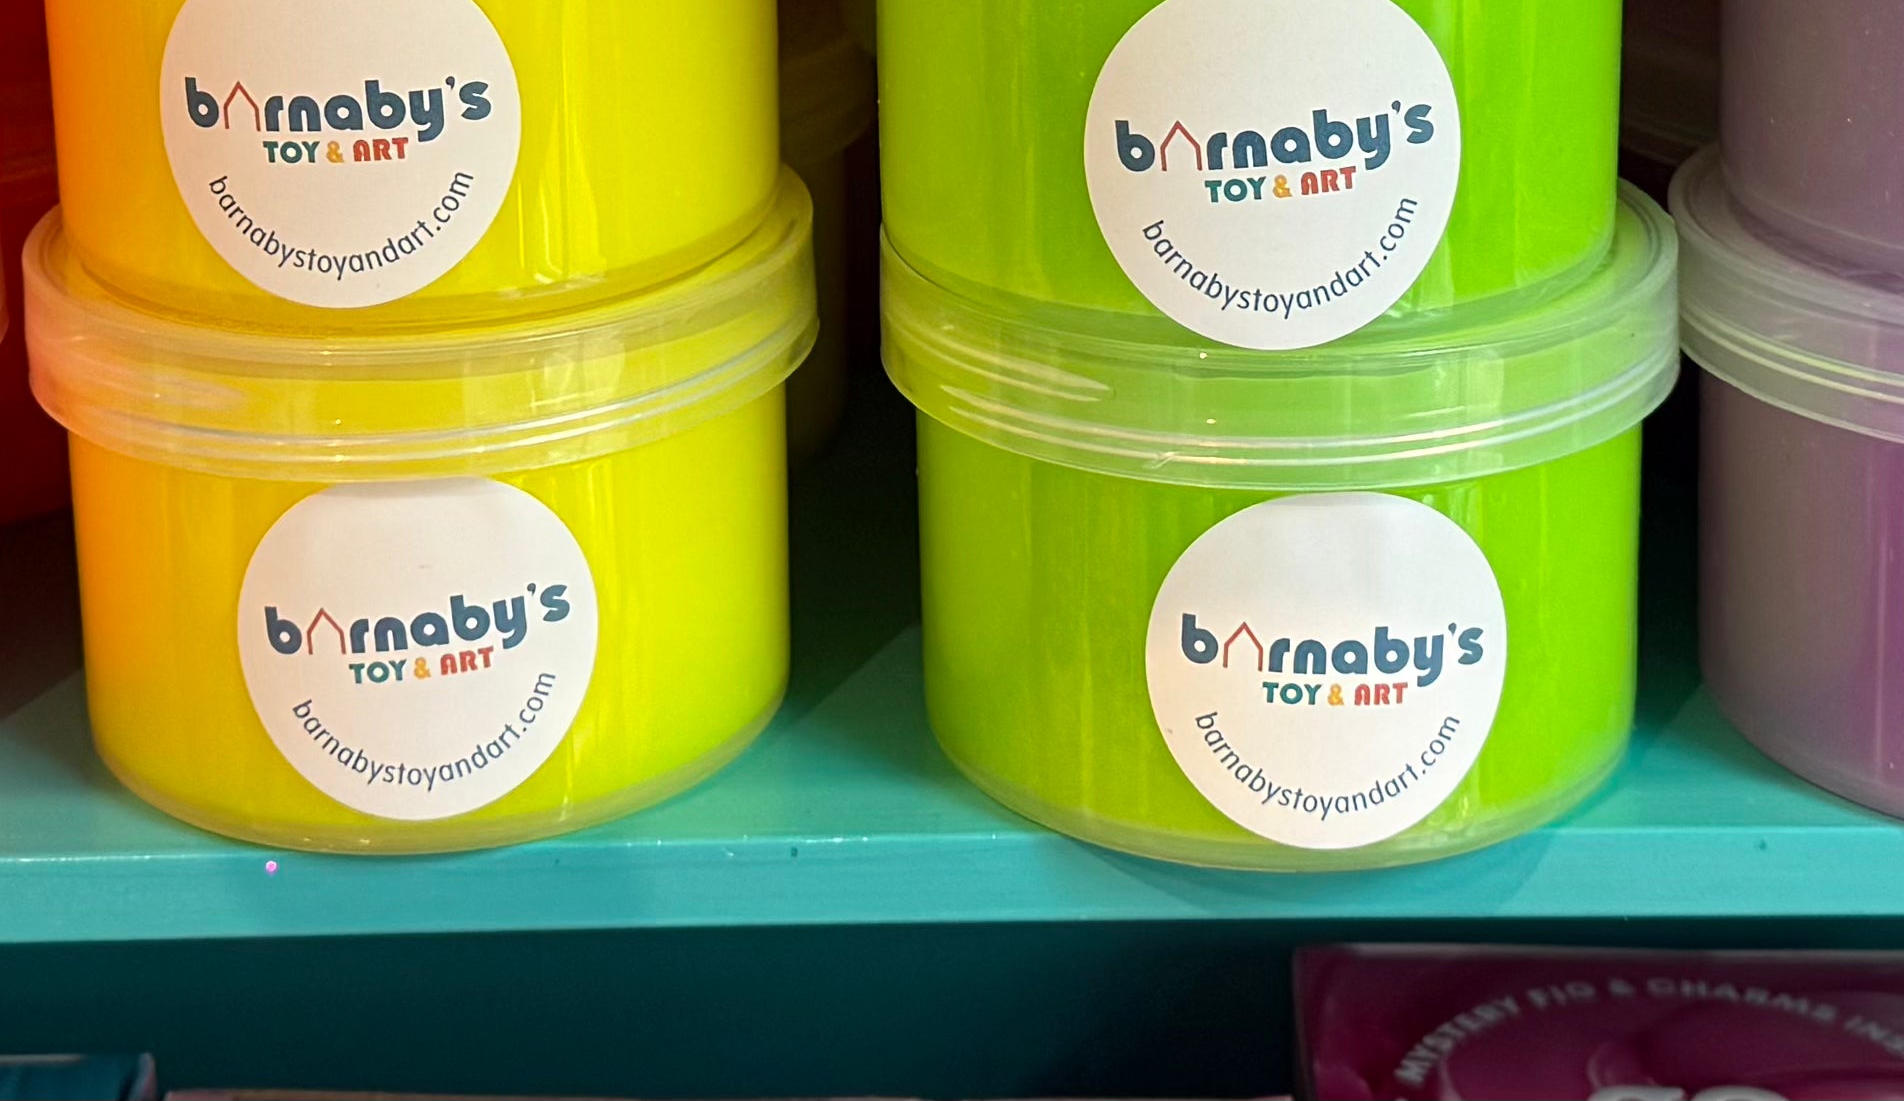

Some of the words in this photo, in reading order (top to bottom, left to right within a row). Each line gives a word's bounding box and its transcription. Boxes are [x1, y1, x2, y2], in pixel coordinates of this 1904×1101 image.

[262, 138, 324, 164] TOY
[327, 139, 346, 164] &
[351, 135, 411, 162] ART
[1203, 176, 1268, 204] TOY
[1273, 172, 1293, 200] &
[1299, 164, 1358, 197] ART
[207, 169, 477, 283] barnabystoyandart.com
[1141, 194, 1418, 320] barnabystoyandart.com
[348, 657, 408, 685] TOY
[413, 654, 432, 681] &
[438, 649, 495, 675] ART
[1261, 679, 1324, 707] TOY
[1328, 681, 1346, 707] &
[1352, 680, 1409, 705] ART
[291, 670, 557, 794] barnabystoyandart.com
[1193, 710, 1461, 822] barnabystoyandart.com
[1393, 995, 1520, 1088] MYSTERY
[1526, 980, 1596, 1009] FIG
[1608, 977, 1635, 997] &
[1646, 977, 1837, 1024] CHARMS
